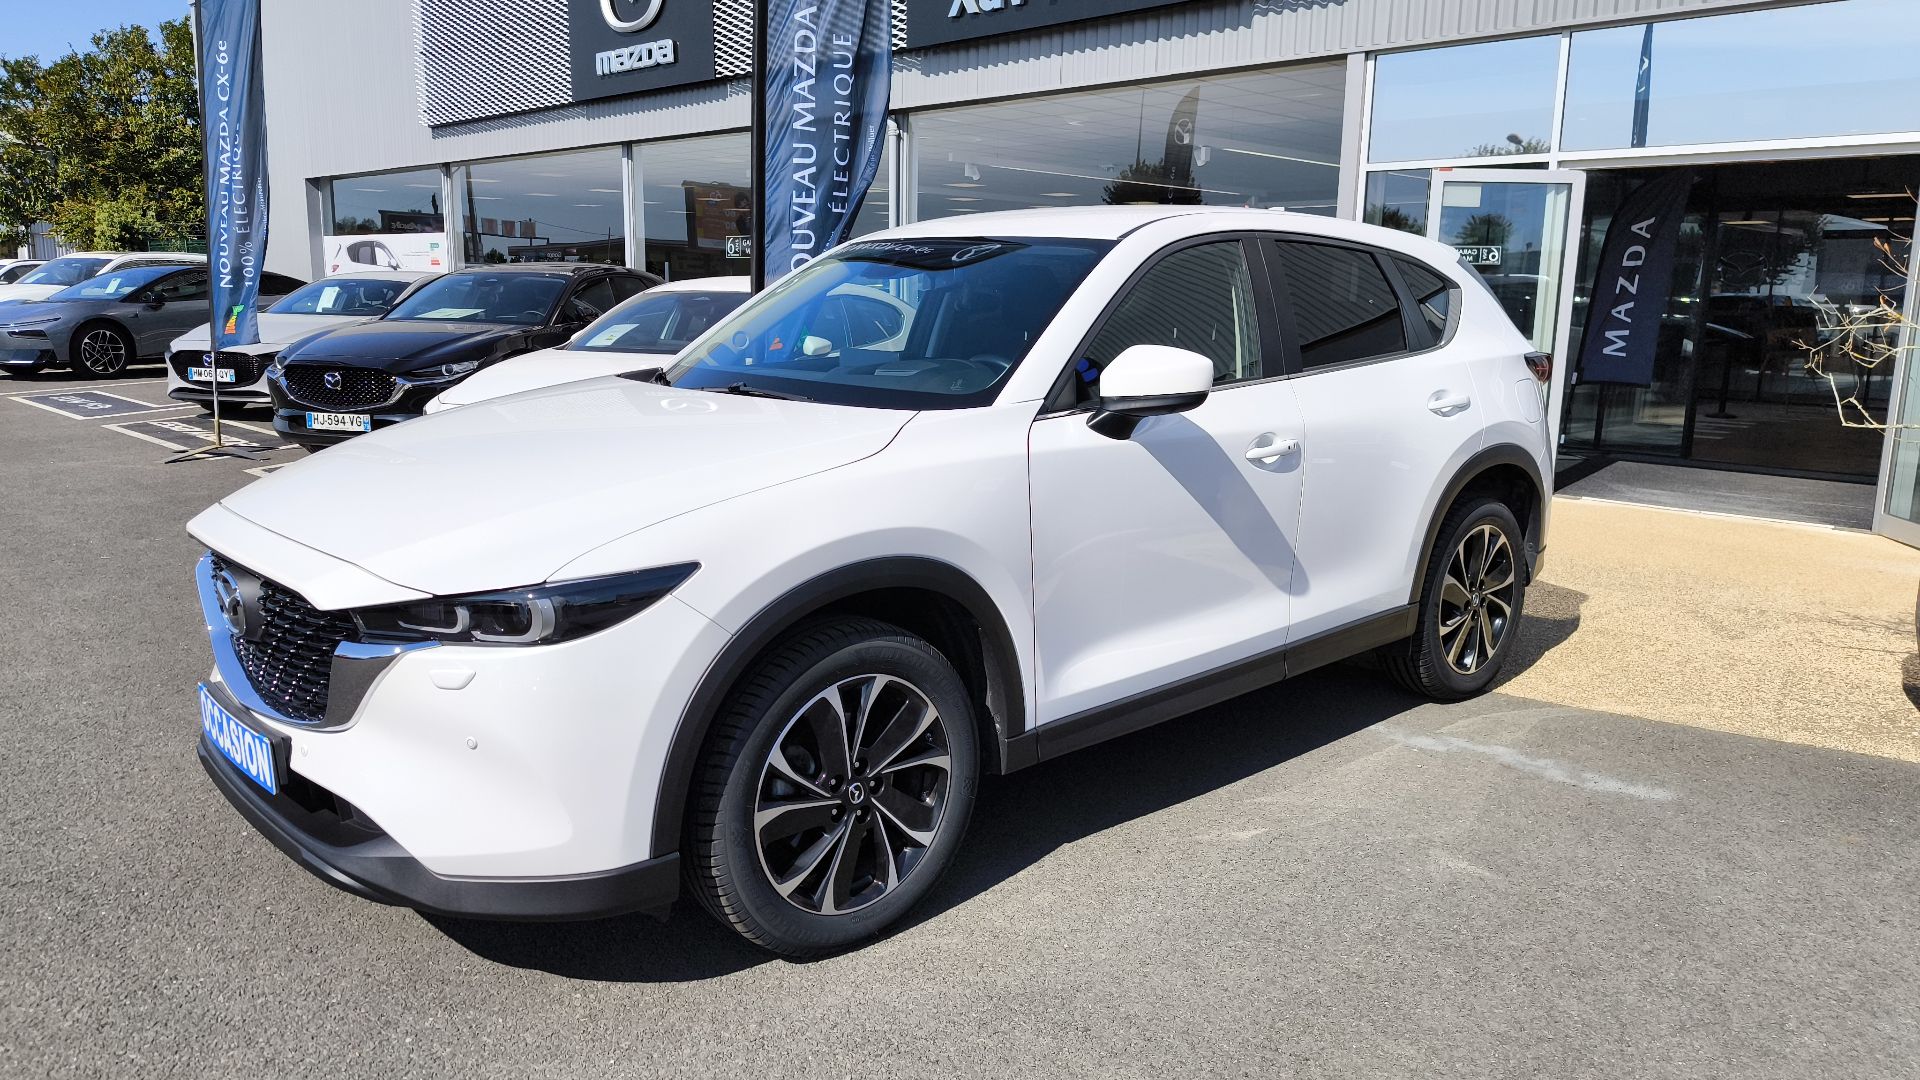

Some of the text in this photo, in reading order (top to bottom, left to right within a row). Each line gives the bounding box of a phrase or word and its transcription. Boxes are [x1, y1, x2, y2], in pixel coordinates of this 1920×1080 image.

[215, 40, 234, 289] NOUVEAU MAZDA CX-6e
[790, 5, 818, 271] OUVEAU MAZDA
[828, 32, 855, 214] ÉLECTRIQUE
[231, 122, 255, 288] 100% ÉLECTRIQ
[728, 238, 735, 254] 6
[1602, 216, 1656, 358] MAZDA
[313, 413, 362, 427] HJ-594-VG
[200, 690, 273, 789] OCCASION
